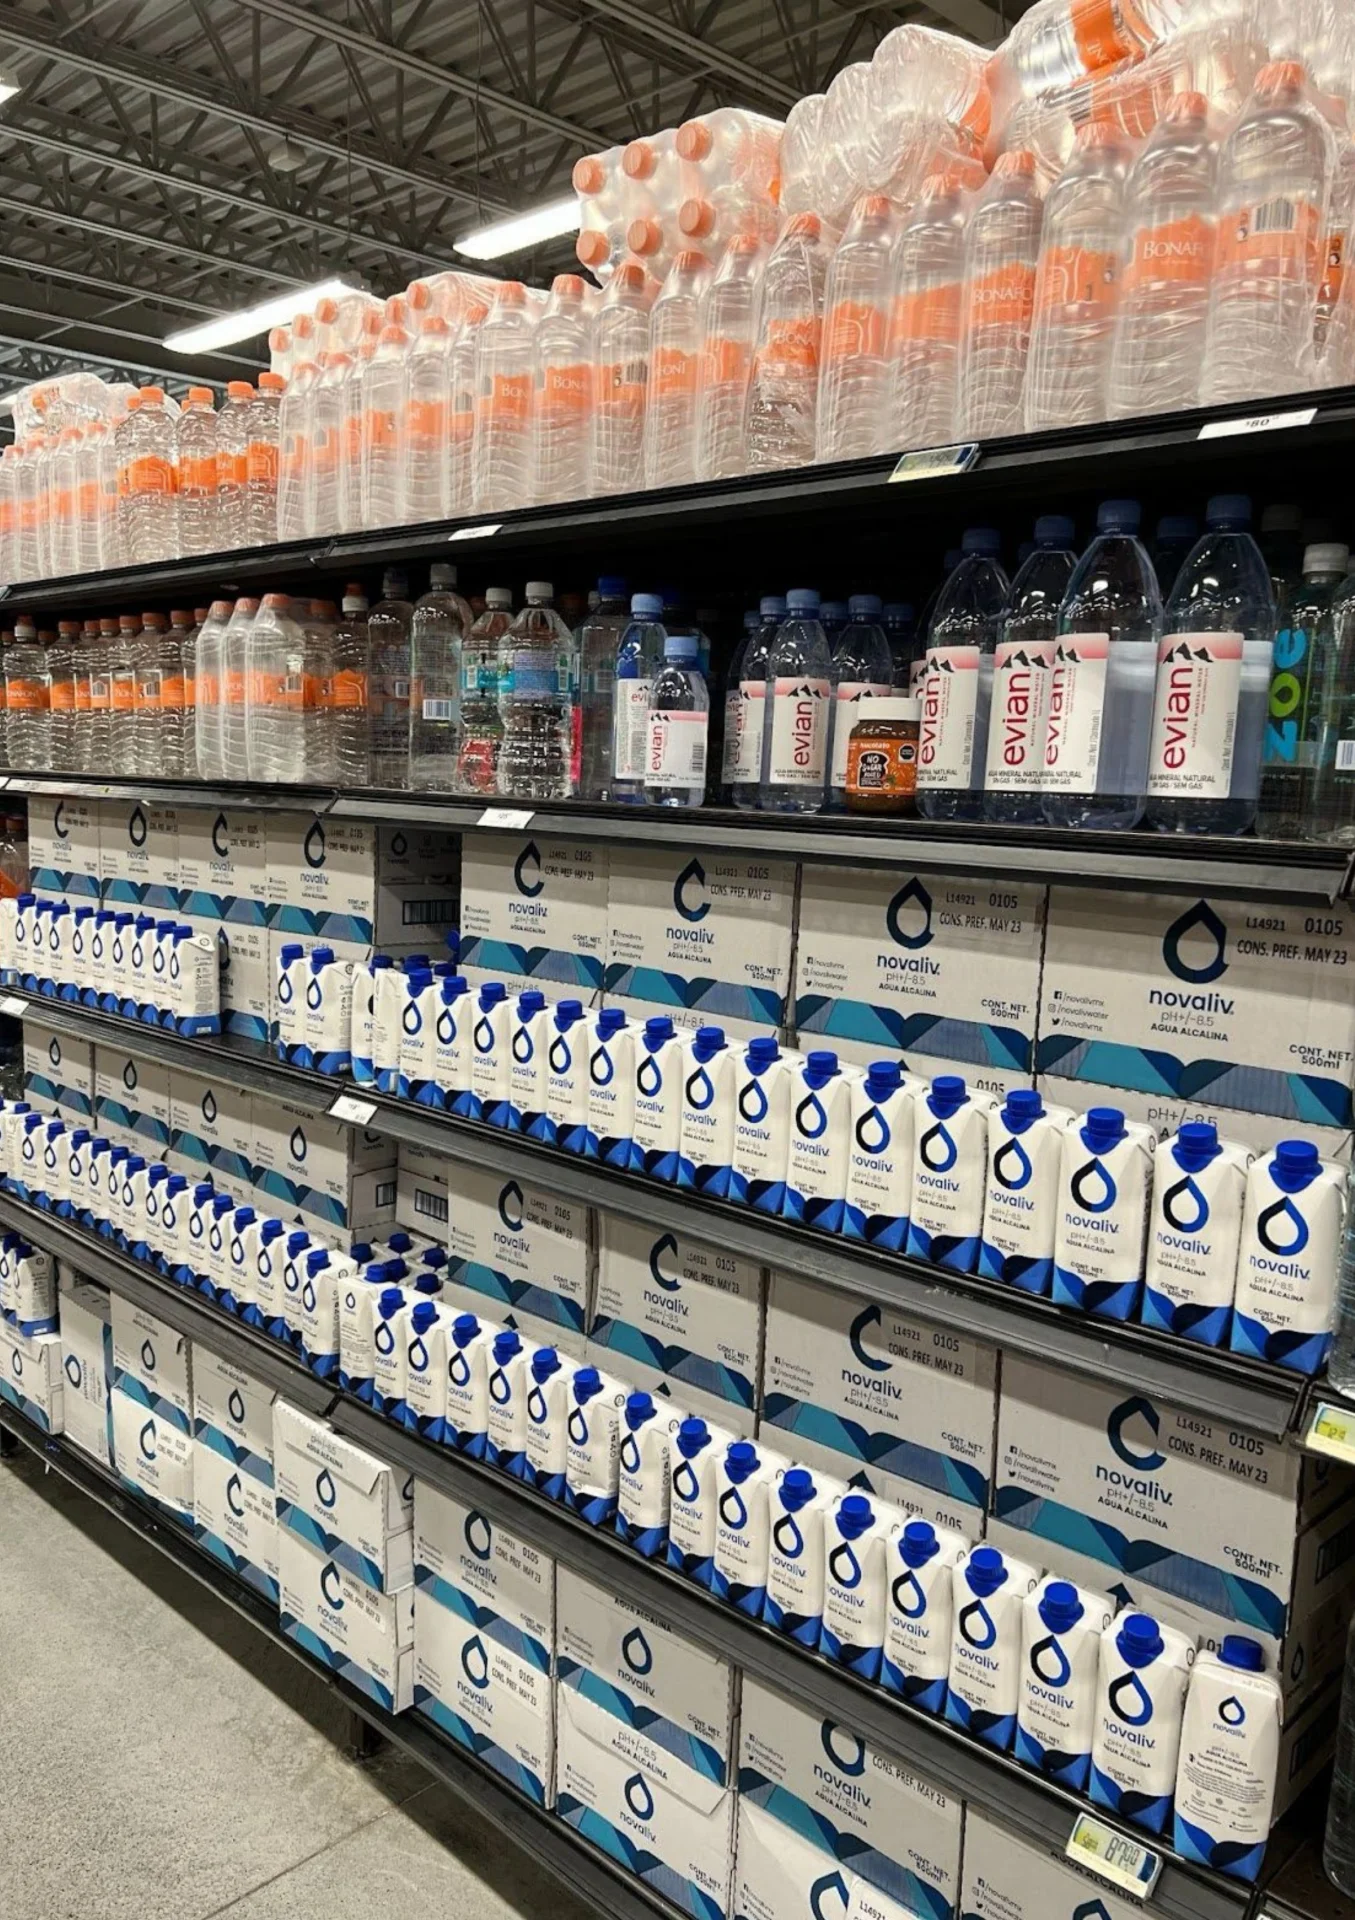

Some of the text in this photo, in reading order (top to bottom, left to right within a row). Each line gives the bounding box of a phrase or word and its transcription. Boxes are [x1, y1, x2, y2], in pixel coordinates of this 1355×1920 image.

[922, 677, 940, 764] evian
[1003, 673, 1031, 766] evian
[1163, 667, 1194, 769] evian
[792, 701, 813, 766] evian
[651, 725, 662, 771] evian
[867, 755, 879, 763] NO
[763, 891, 771, 900] 23
[989, 893, 1018, 908] 0105
[509, 902, 548, 917] novaliv
[940, 912, 1021, 933] CONS. PREF. MAY 23
[1246, 918, 1342, 936] L14921 0105
[666, 927, 715, 944] novaliv
[1237, 940, 1348, 964] CONS. PREF. MAY 23
[877, 955, 940, 975] novaliv
[879, 983, 936, 997] AGUA ALCALINA
[1149, 990, 1234, 1015] novaliv
[1151, 1023, 1228, 1042] AGUA ALCALINA
[1289, 1044, 1325, 1059] CONT.
[1302, 1055, 1340, 1069] 500ml
[1065, 1212, 1119, 1233] novaliv
[1157, 1231, 1212, 1255] novaliv
[715, 1257, 736, 1273] 0105
[1249, 1255, 1310, 1280] novaliv
[718, 1279, 731, 1291] MAY
[732, 1284, 739, 1294] 23
[1268, 1287, 1304, 1302] ALCALINA
[644, 1290, 690, 1317] novaliv
[933, 1333, 959, 1352] 0105
[889, 1343, 964, 1376] CONS. PREF. MAY 23
[842, 1368, 903, 1400] novaliv
[1177, 1416, 1264, 1456] L14921 0105
[1168, 1436, 1268, 1484] CONS. PREF. MAY 23
[1096, 1464, 1173, 1506] novaliv
[1098, 1496, 1168, 1530] AGUA ALCALINA
[1223, 1546, 1257, 1564] CONT.
[1234, 1558, 1270, 1578] 500ml
[1104, 1717, 1156, 1749] novaliv
[612, 1740, 668, 1780] AGUA ALCALINA
[813, 1763, 871, 1809] novaliv
[873, 1755, 946, 1808] CONS. PREF. MAY 23
